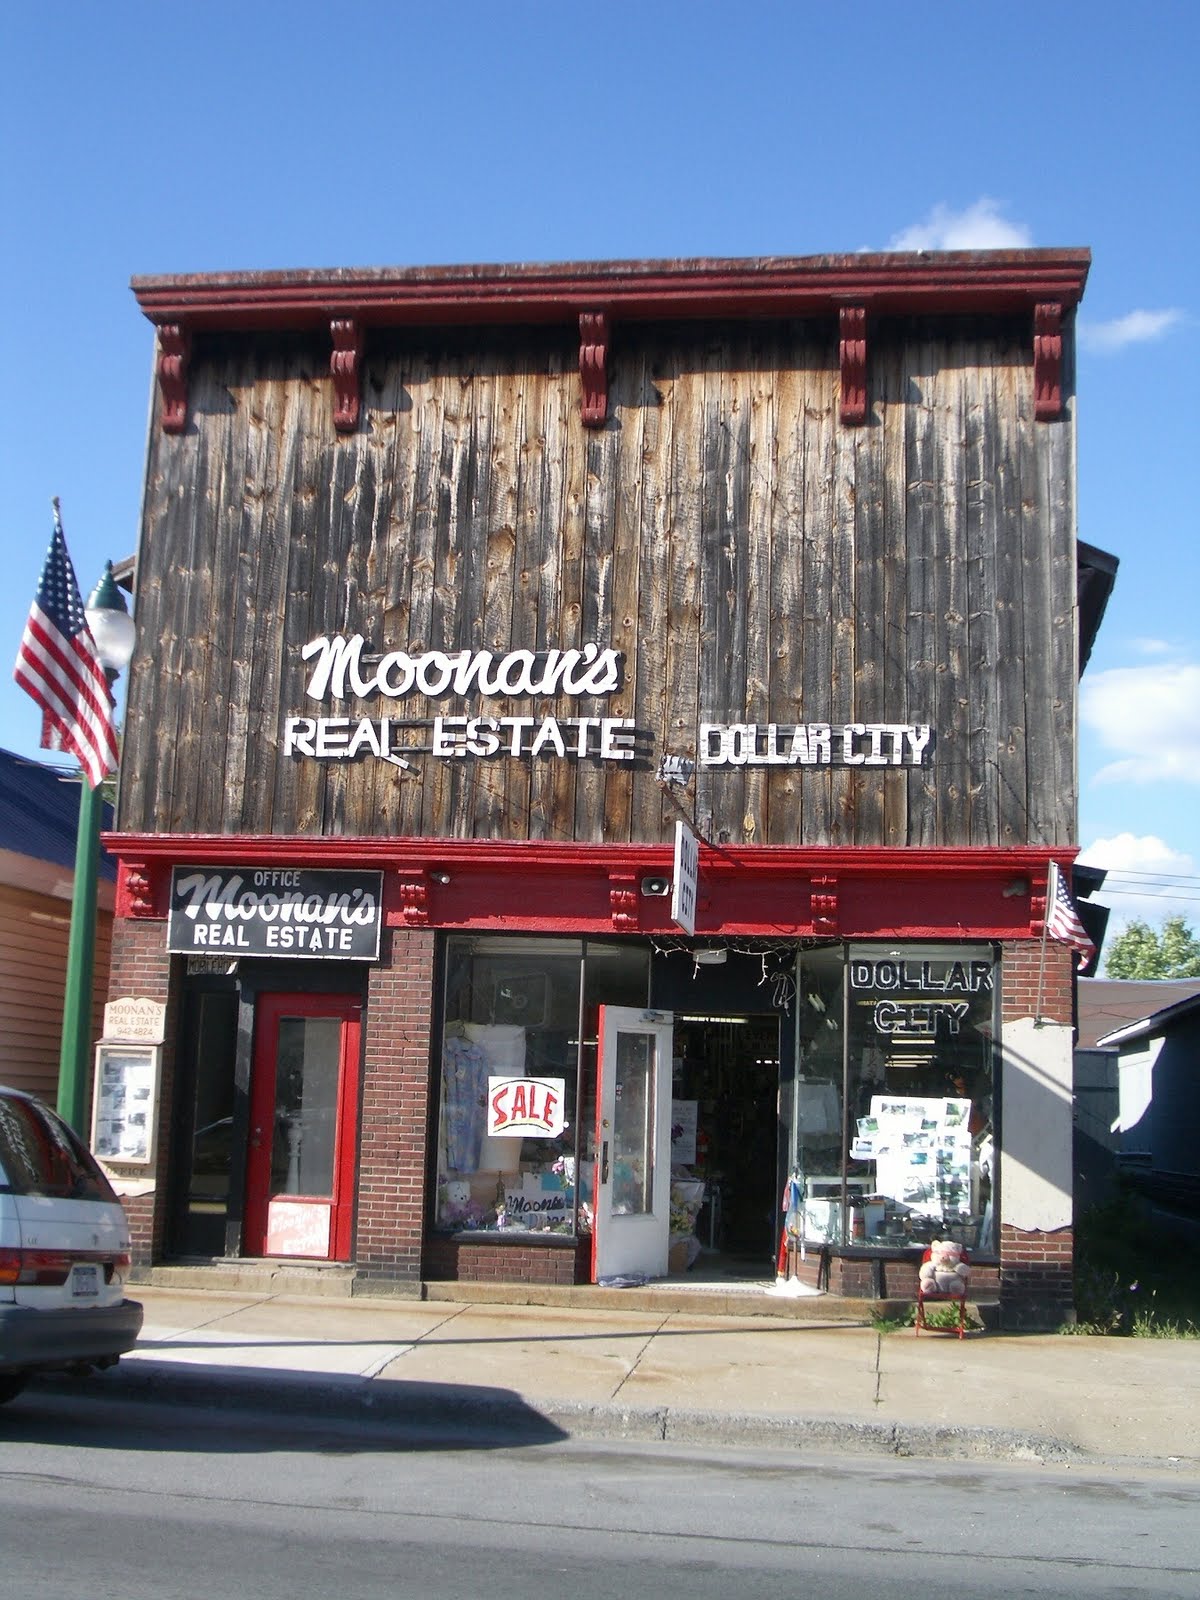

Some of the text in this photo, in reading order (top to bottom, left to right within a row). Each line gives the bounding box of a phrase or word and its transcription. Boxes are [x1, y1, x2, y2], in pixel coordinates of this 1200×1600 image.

[301, 633, 619, 700] Moonan's
[283, 716, 636, 769] REAL ESTATE
[699, 722, 932, 766] DOLLAR CITY
[253, 871, 300, 887] OFFICE
[176, 873, 375, 926] Moonan's
[193, 924, 353, 952] REAL ESTATE
[851, 960, 993, 992] DOLLAR
[109, 1016, 160, 1027] REAL ESTATE
[874, 999, 969, 1034] CITY
[492, 1085, 558, 1128] SALE
[106, 1166, 146, 1176] OFFICE
